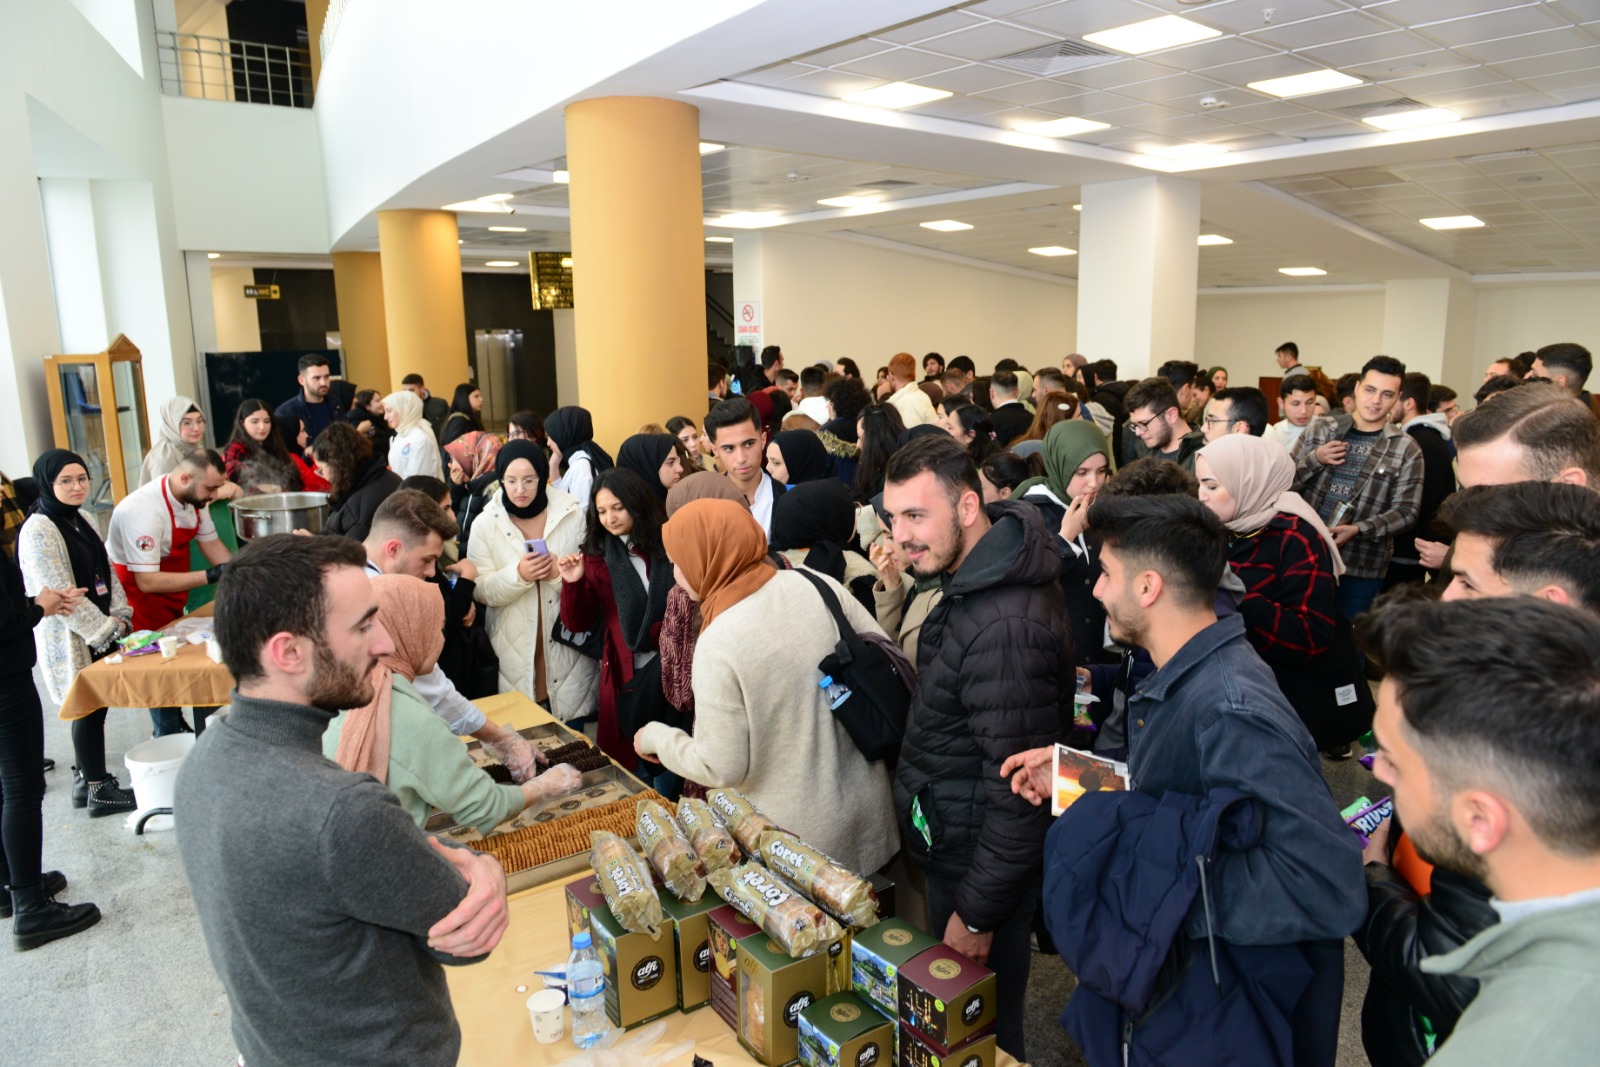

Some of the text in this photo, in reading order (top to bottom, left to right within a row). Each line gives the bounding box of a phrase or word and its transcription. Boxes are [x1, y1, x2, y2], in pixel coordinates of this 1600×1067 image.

[770, 841, 804, 868] Çörek
[743, 870, 791, 907] Çörek
[637, 960, 658, 978] alfi
[790, 996, 809, 1013] alfi
[966, 999, 980, 1015] alfi
[860, 1046, 875, 1062] alfi
